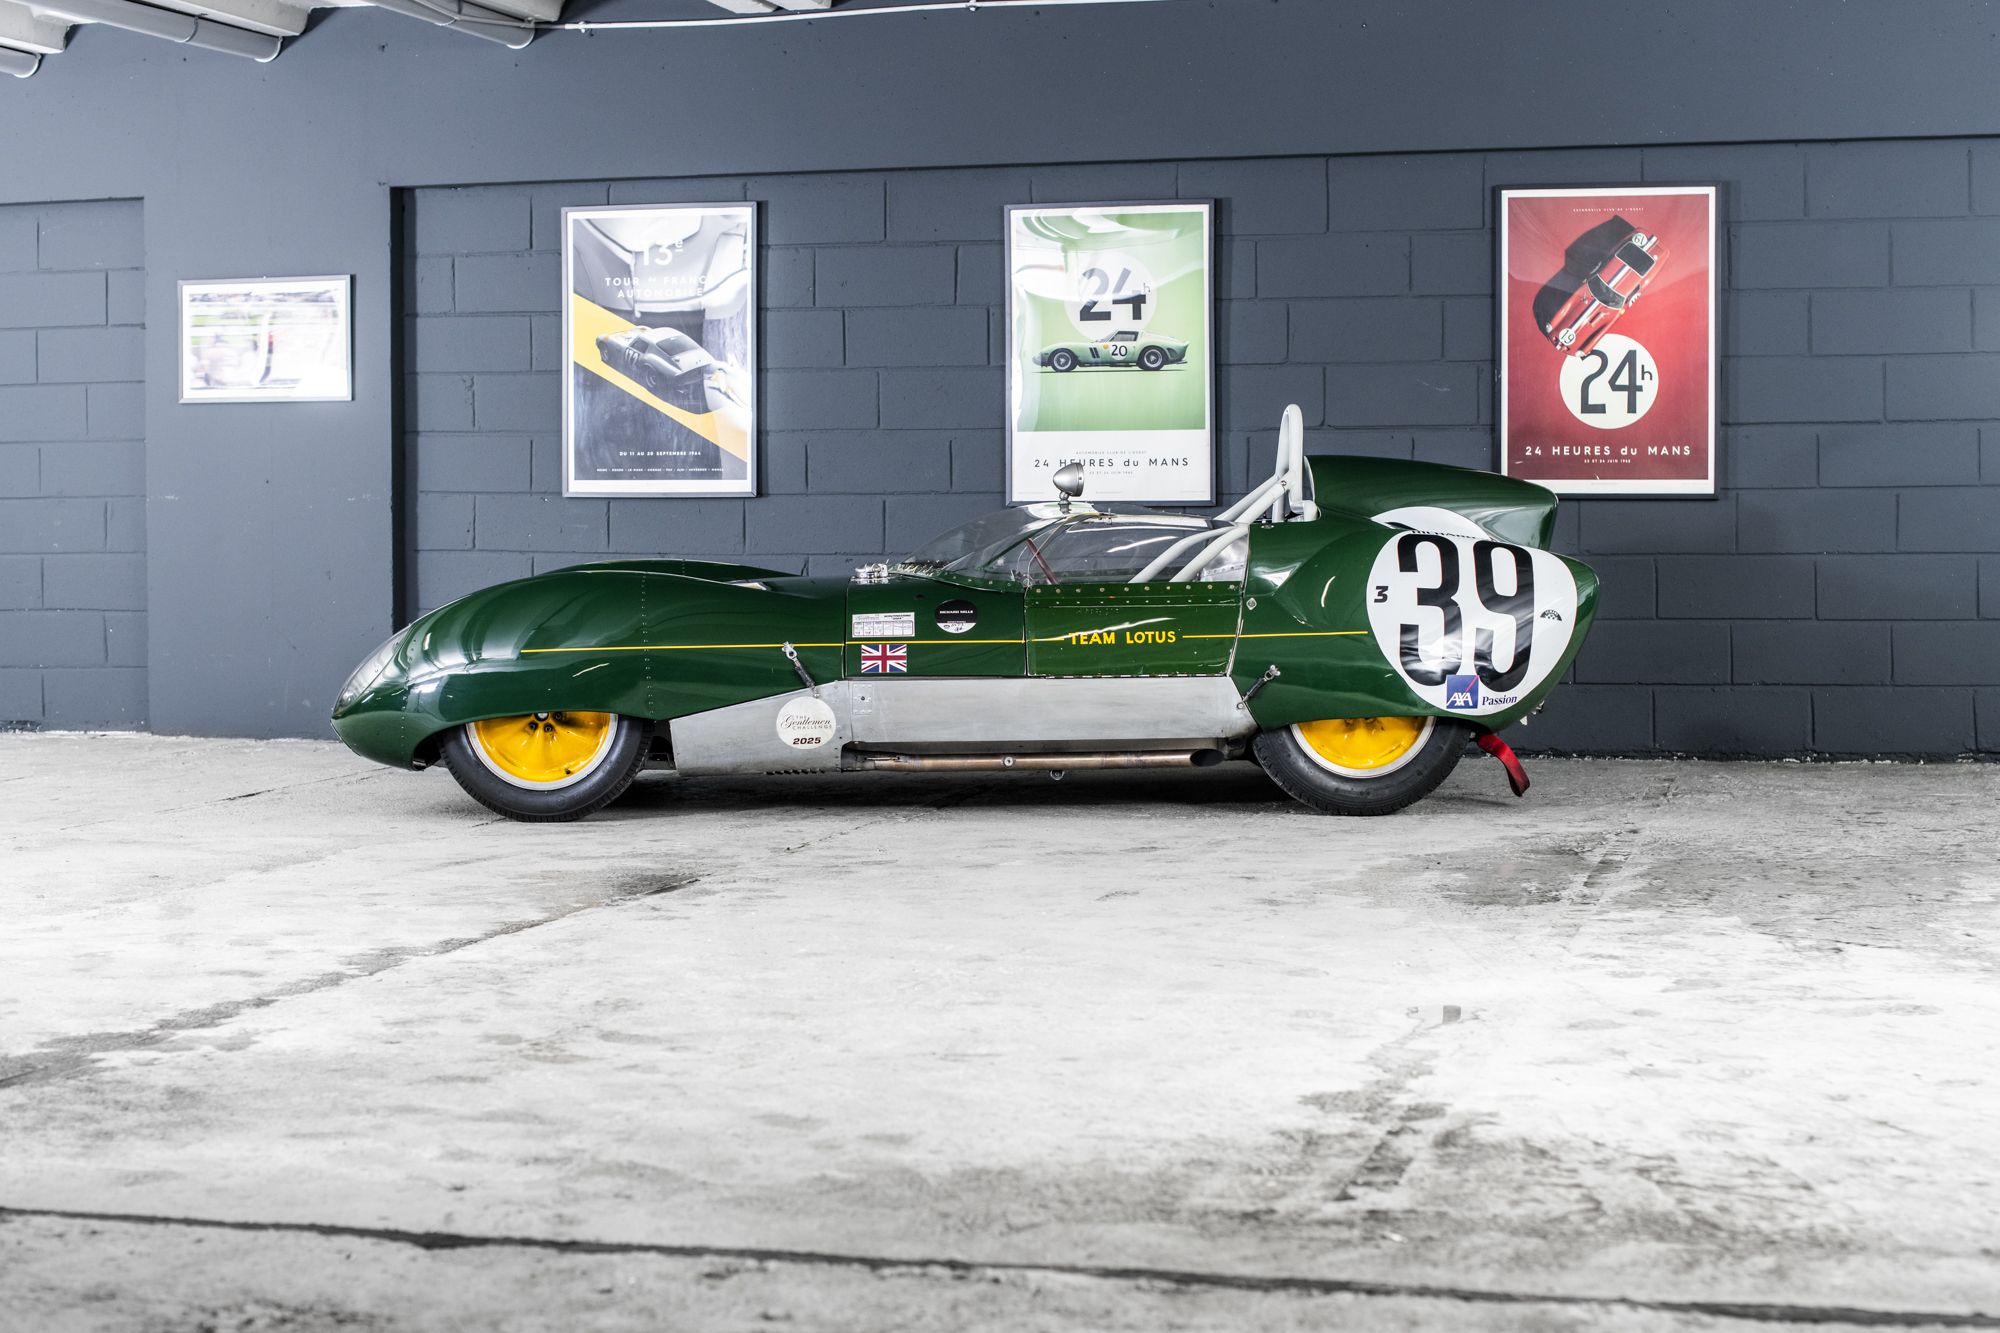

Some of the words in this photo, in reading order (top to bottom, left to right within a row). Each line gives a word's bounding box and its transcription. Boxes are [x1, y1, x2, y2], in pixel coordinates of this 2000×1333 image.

[605, 277, 640, 287] TOUR
[1111, 344, 1128, 357] 20
[1525, 446, 1542, 456] 24
[1552, 445, 1611, 456] HEURES
[1620, 446, 1638, 456] du
[1648, 445, 1691, 456] MANS
[1034, 459, 1049, 468] 24
[1123, 458, 1139, 467] du
[1148, 457, 1189, 467] MANS
[1373, 586, 1389, 603] 3
[1397, 533, 1535, 693] 39
[1068, 632, 1116, 645] TEAM
[1126, 631, 1176, 644] LOTUS
[1446, 692, 1474, 707] AXA
[1482, 695, 1518, 706] Passion
[780, 713, 831, 729] Gentlemen
[792, 736, 822, 745] 2025
